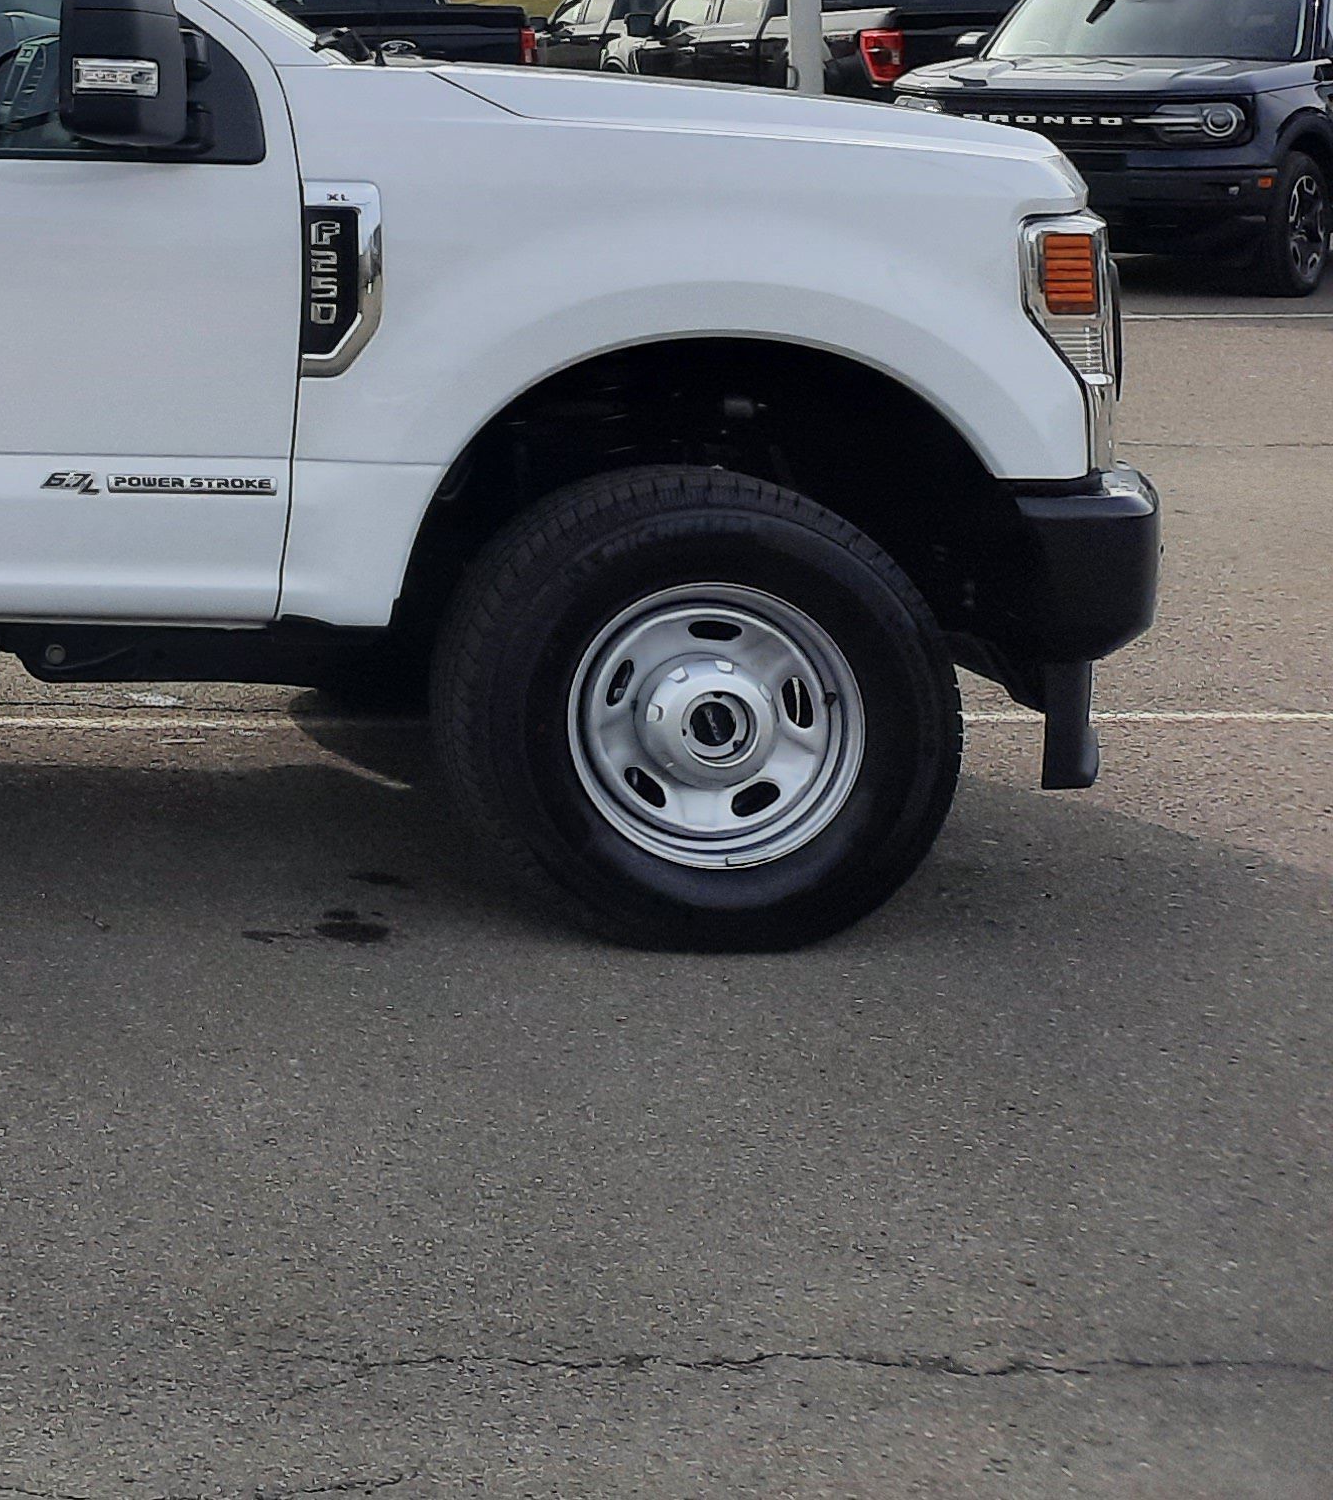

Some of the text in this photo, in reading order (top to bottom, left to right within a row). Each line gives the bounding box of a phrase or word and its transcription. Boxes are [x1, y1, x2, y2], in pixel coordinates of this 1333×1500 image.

[326, 193, 349, 201] XL
[40, 472, 271, 495] 6.7L POWER STROKE
